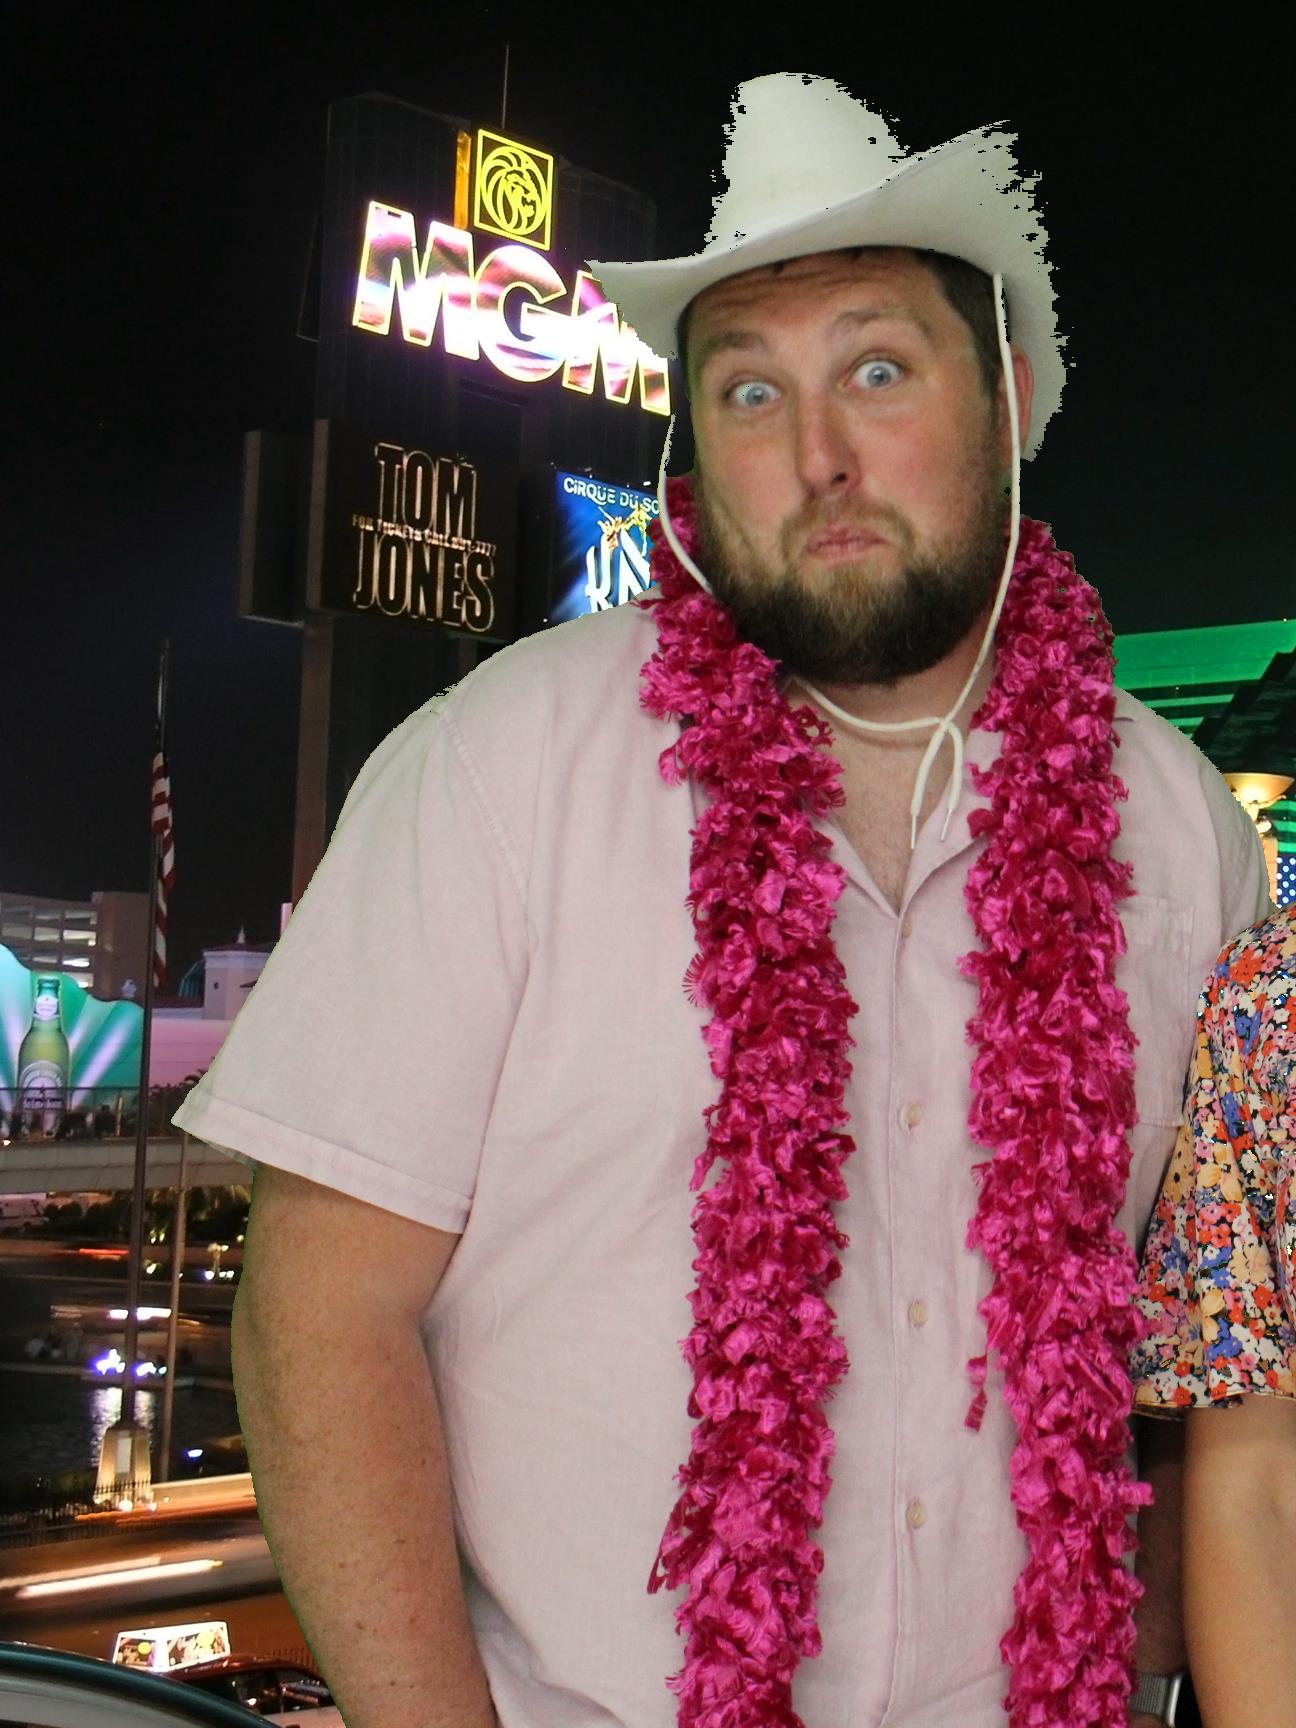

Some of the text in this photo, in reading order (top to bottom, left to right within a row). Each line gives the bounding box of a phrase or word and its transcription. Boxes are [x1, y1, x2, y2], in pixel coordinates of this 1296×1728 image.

[353, 200, 671, 416] MGM
[374, 442, 477, 540] TOM
[352, 530, 495, 632] JONES
